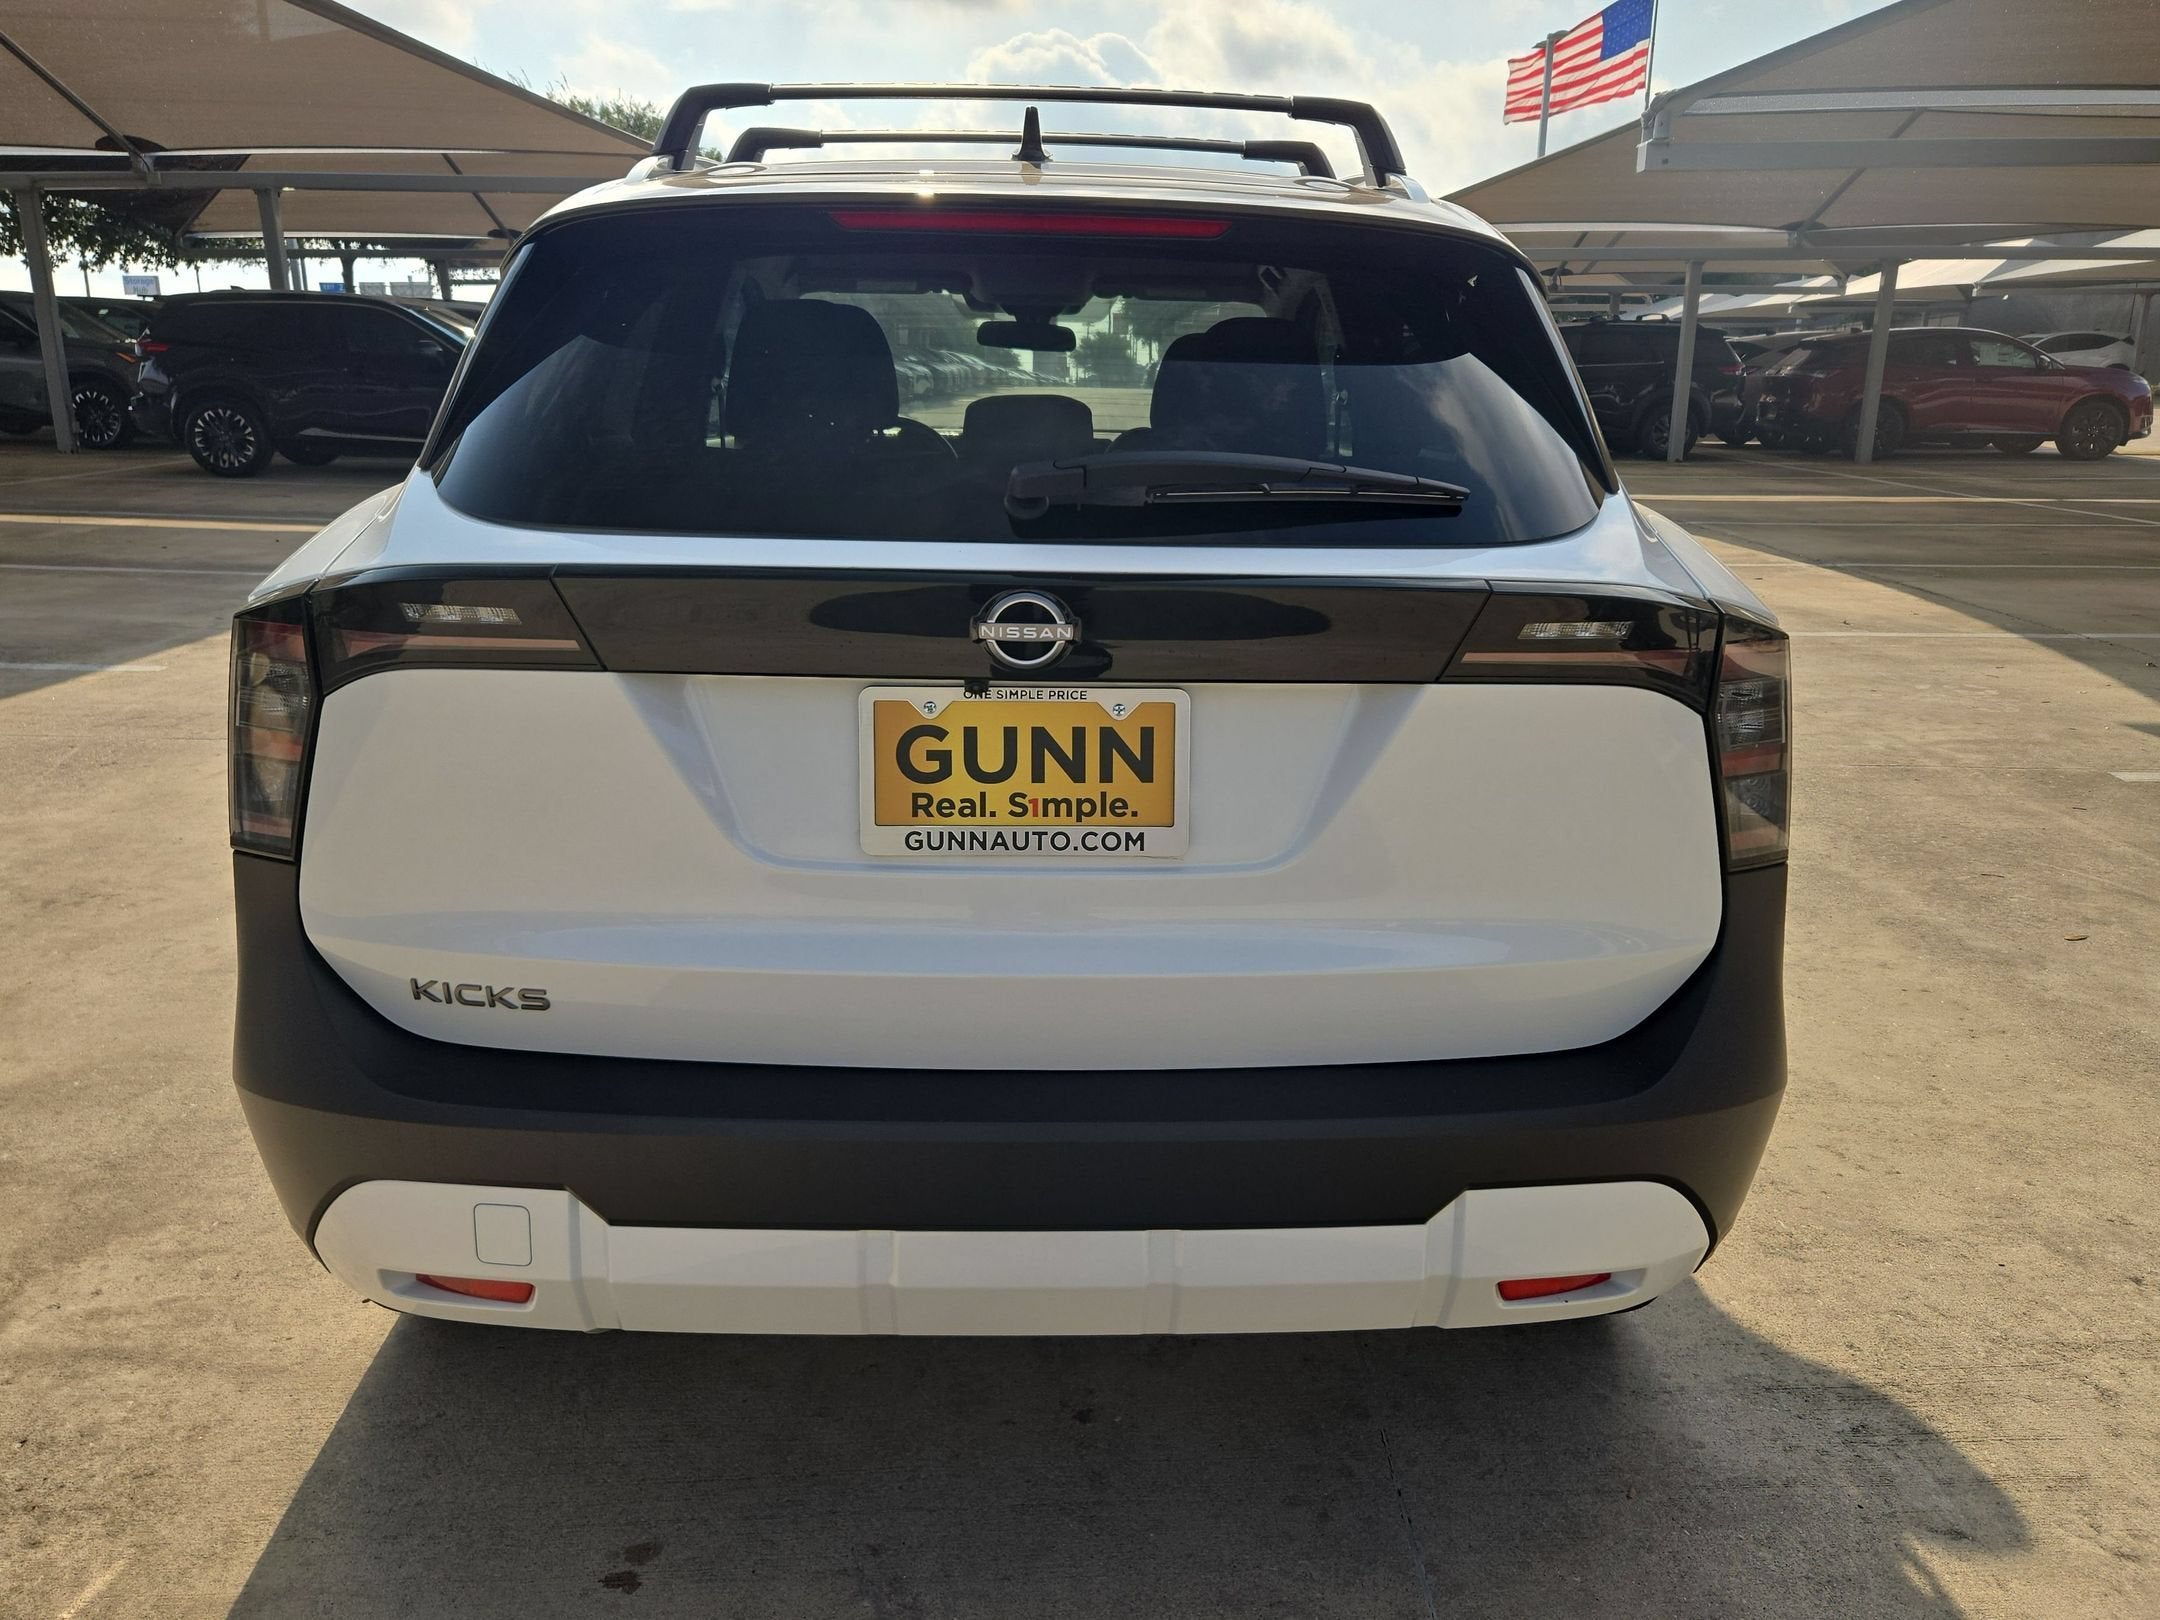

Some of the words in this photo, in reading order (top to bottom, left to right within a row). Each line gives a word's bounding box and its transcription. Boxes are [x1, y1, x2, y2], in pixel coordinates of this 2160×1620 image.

[981, 625, 1071, 639] NISSAN
[996, 689, 1044, 700] SIMPLE
[1048, 690, 1088, 700] PRICE
[895, 724, 1155, 785] GUNN
[911, 791, 997, 818] Real.
[904, 830, 1145, 852] GUNNAUTO.COM
[410, 977, 551, 1011] KICKS
